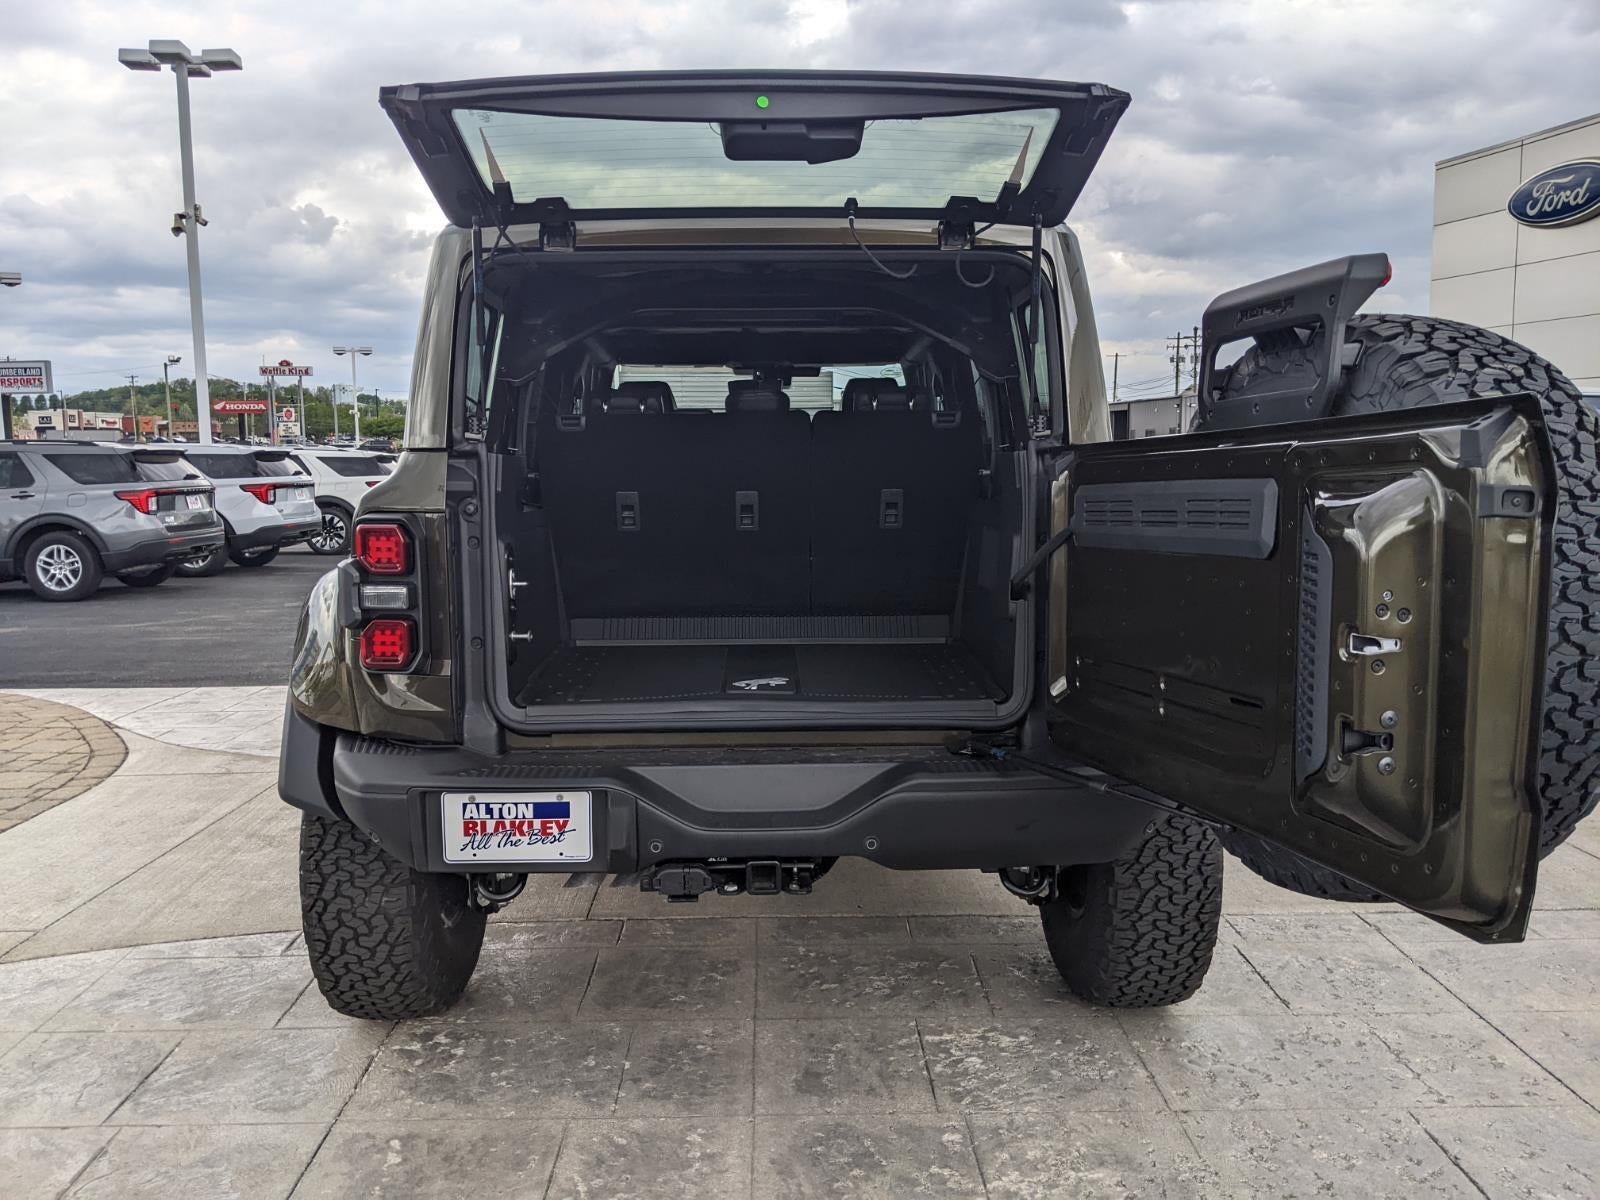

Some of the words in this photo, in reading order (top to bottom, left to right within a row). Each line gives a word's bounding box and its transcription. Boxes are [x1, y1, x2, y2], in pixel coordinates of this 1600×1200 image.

[1526, 174, 1593, 217] Ford
[288, 367, 310, 376] King
[463, 803, 534, 819] ALTON
[463, 819, 570, 838] BLAKLEY
[460, 832, 493, 852] All
[496, 829, 524, 849] The
[526, 828, 577, 846] Best
